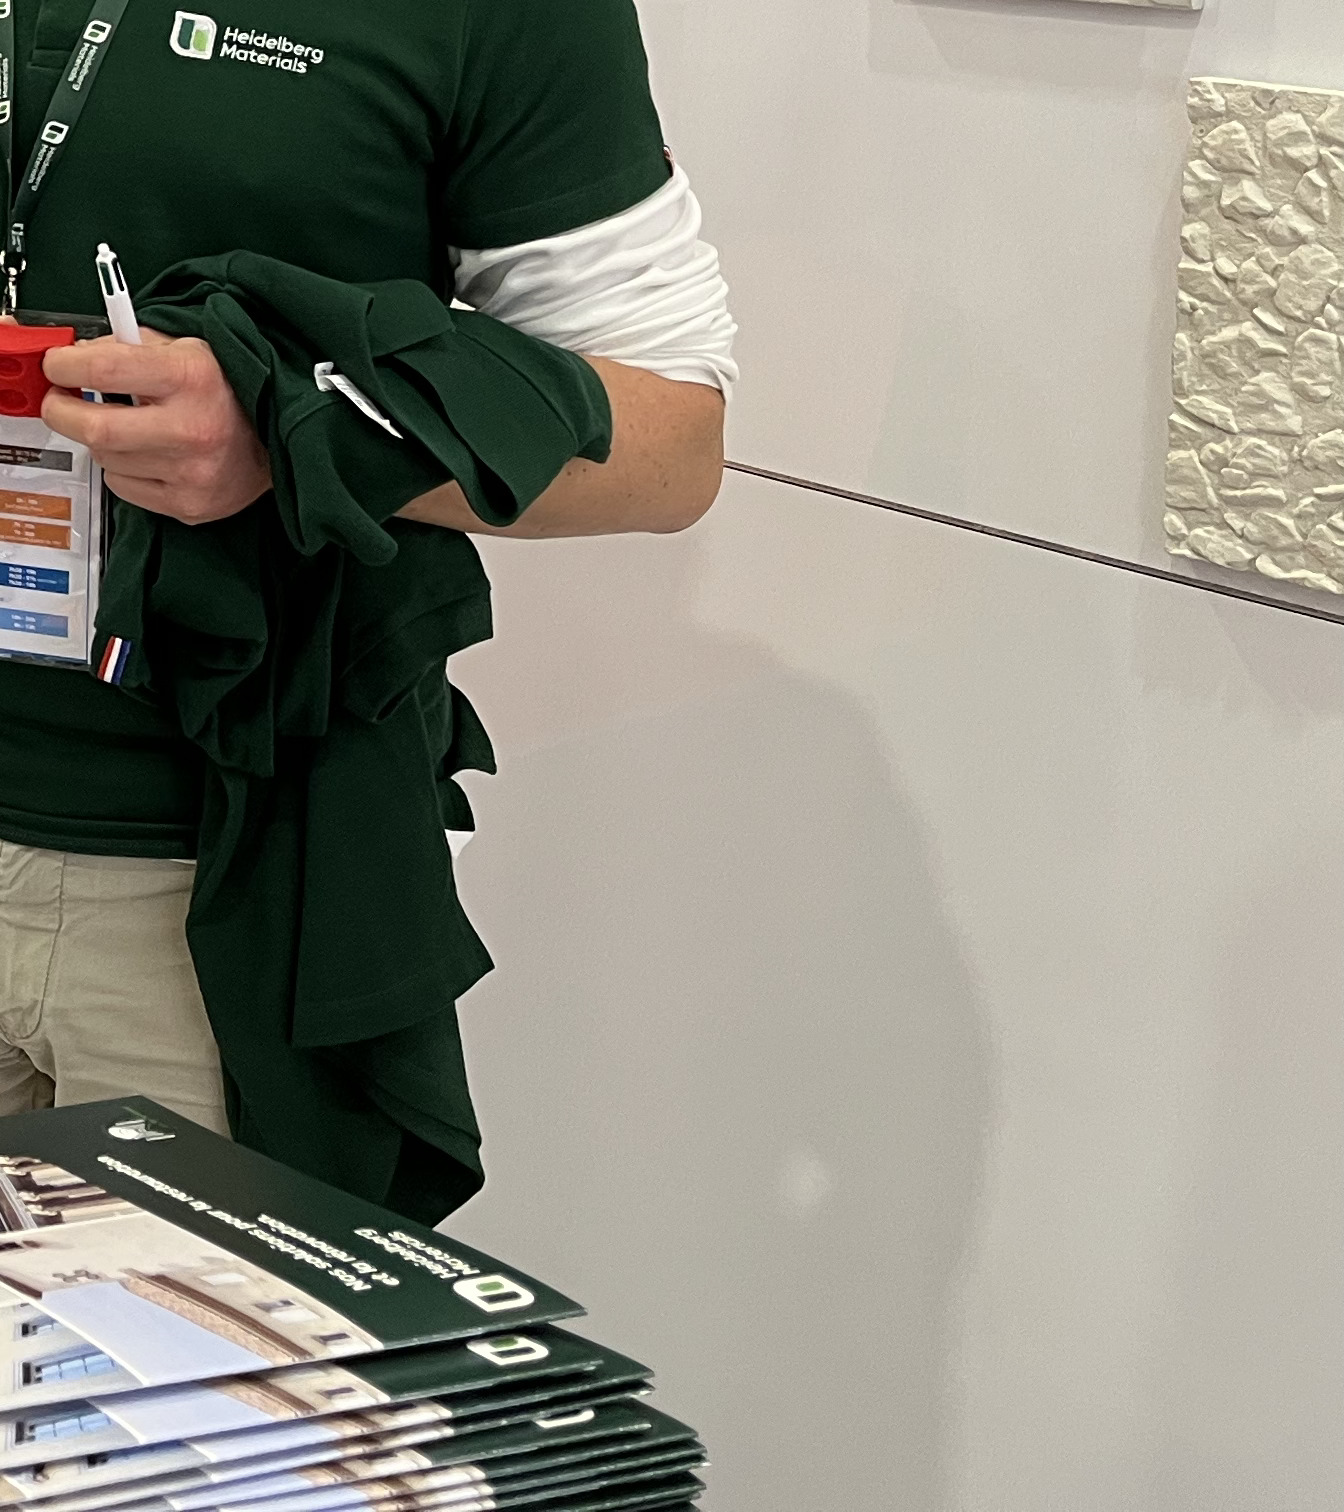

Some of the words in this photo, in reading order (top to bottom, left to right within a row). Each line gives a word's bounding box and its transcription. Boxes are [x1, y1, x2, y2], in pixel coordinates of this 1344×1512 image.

[219, 42, 308, 74] Materials
[223, 26, 324, 64] Heidelberg
[328, 1268, 372, 1291] Nos
